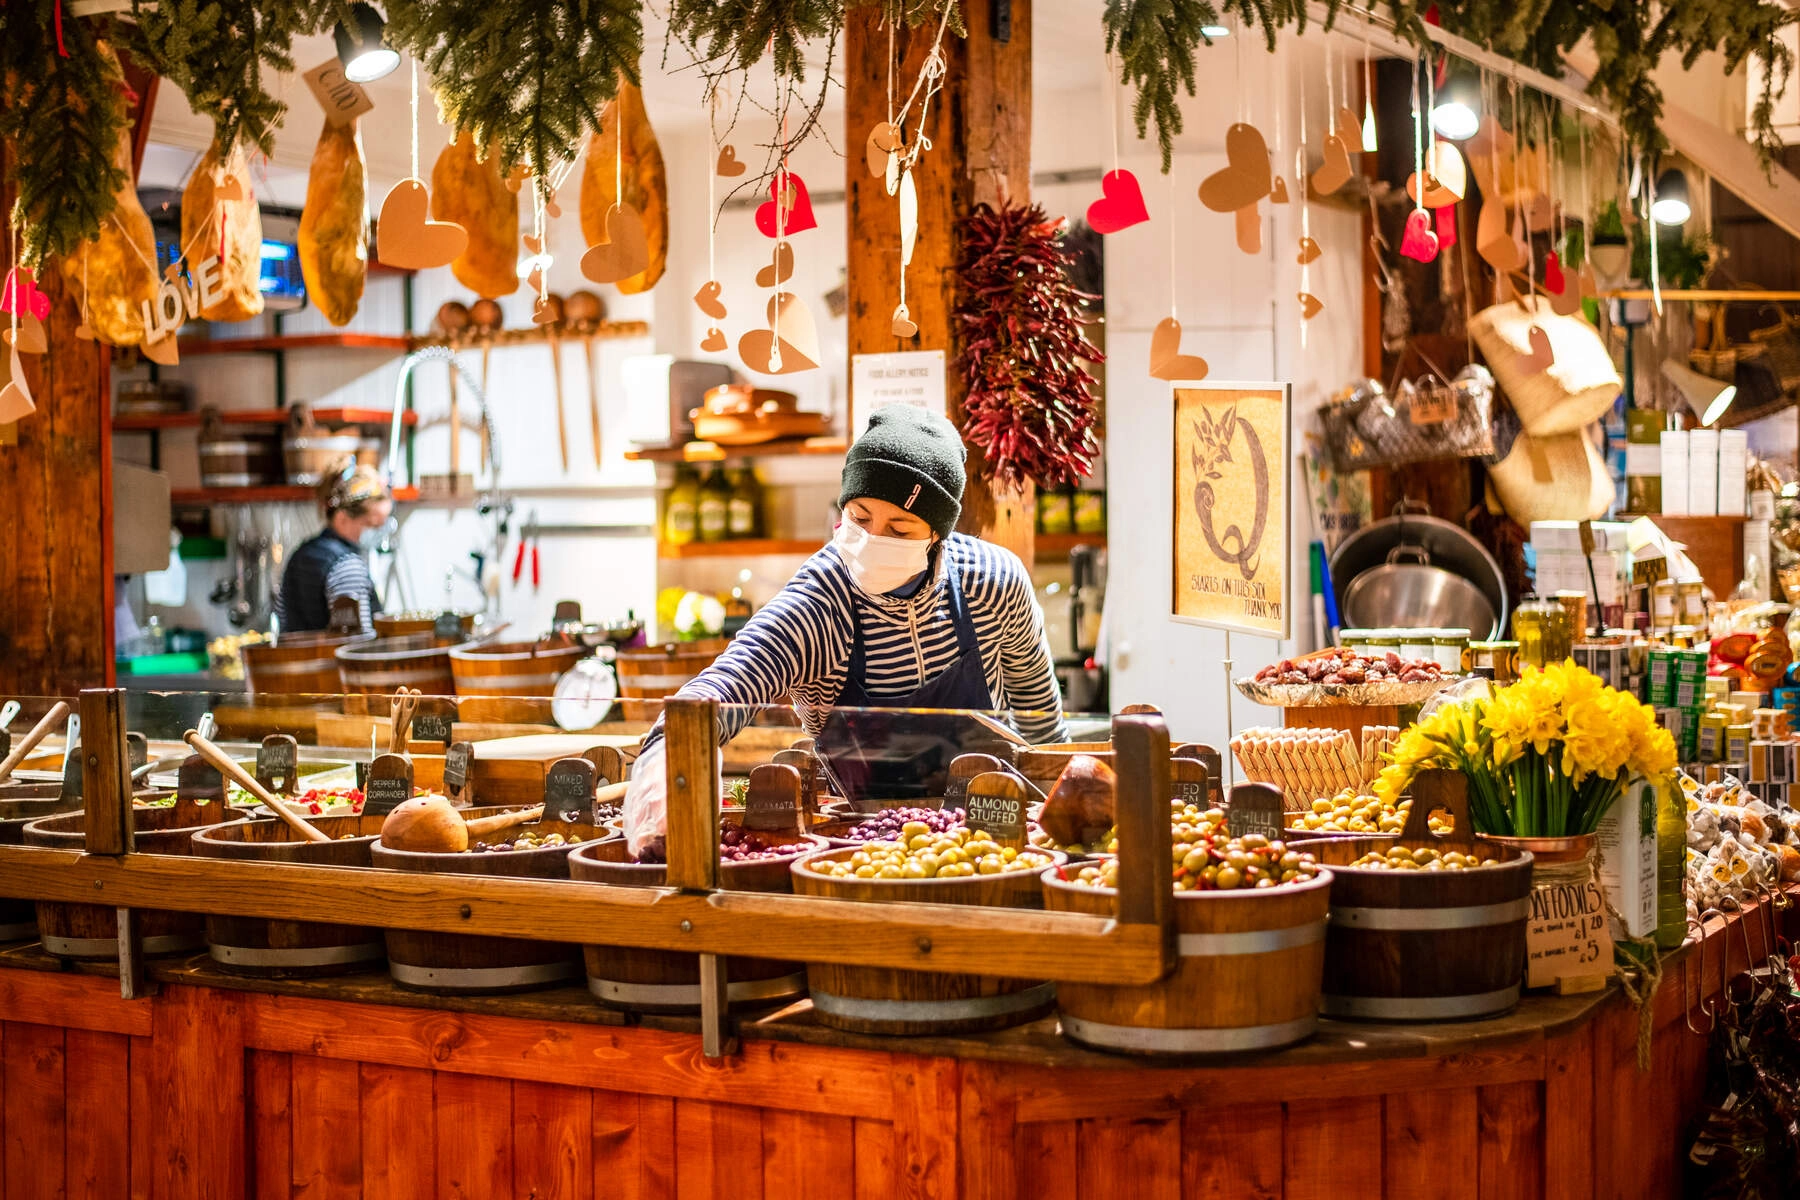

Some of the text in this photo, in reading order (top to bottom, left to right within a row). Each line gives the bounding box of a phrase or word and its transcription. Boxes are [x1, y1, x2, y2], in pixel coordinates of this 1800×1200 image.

[142, 254, 225, 345] LOVE
[909, 367, 929, 377] NOTICE
[1191, 575, 1219, 593] STARTS
[1221, 578, 1232, 595] ON
[1234, 580, 1250, 598] THIS
[1244, 599, 1282, 620] THANK YOU
[422, 716, 442, 726] FETA
[417, 726, 447, 736] SALAD
[554, 774, 583, 785] MIXED
[368, 790, 406, 799] CORRIANDER
[968, 796, 1020, 812] ALMOND
[969, 808, 1017, 824] STUFFED
[1230, 809, 1272, 825] CHILLI
[1229, 823, 1278, 838] TUFFED
